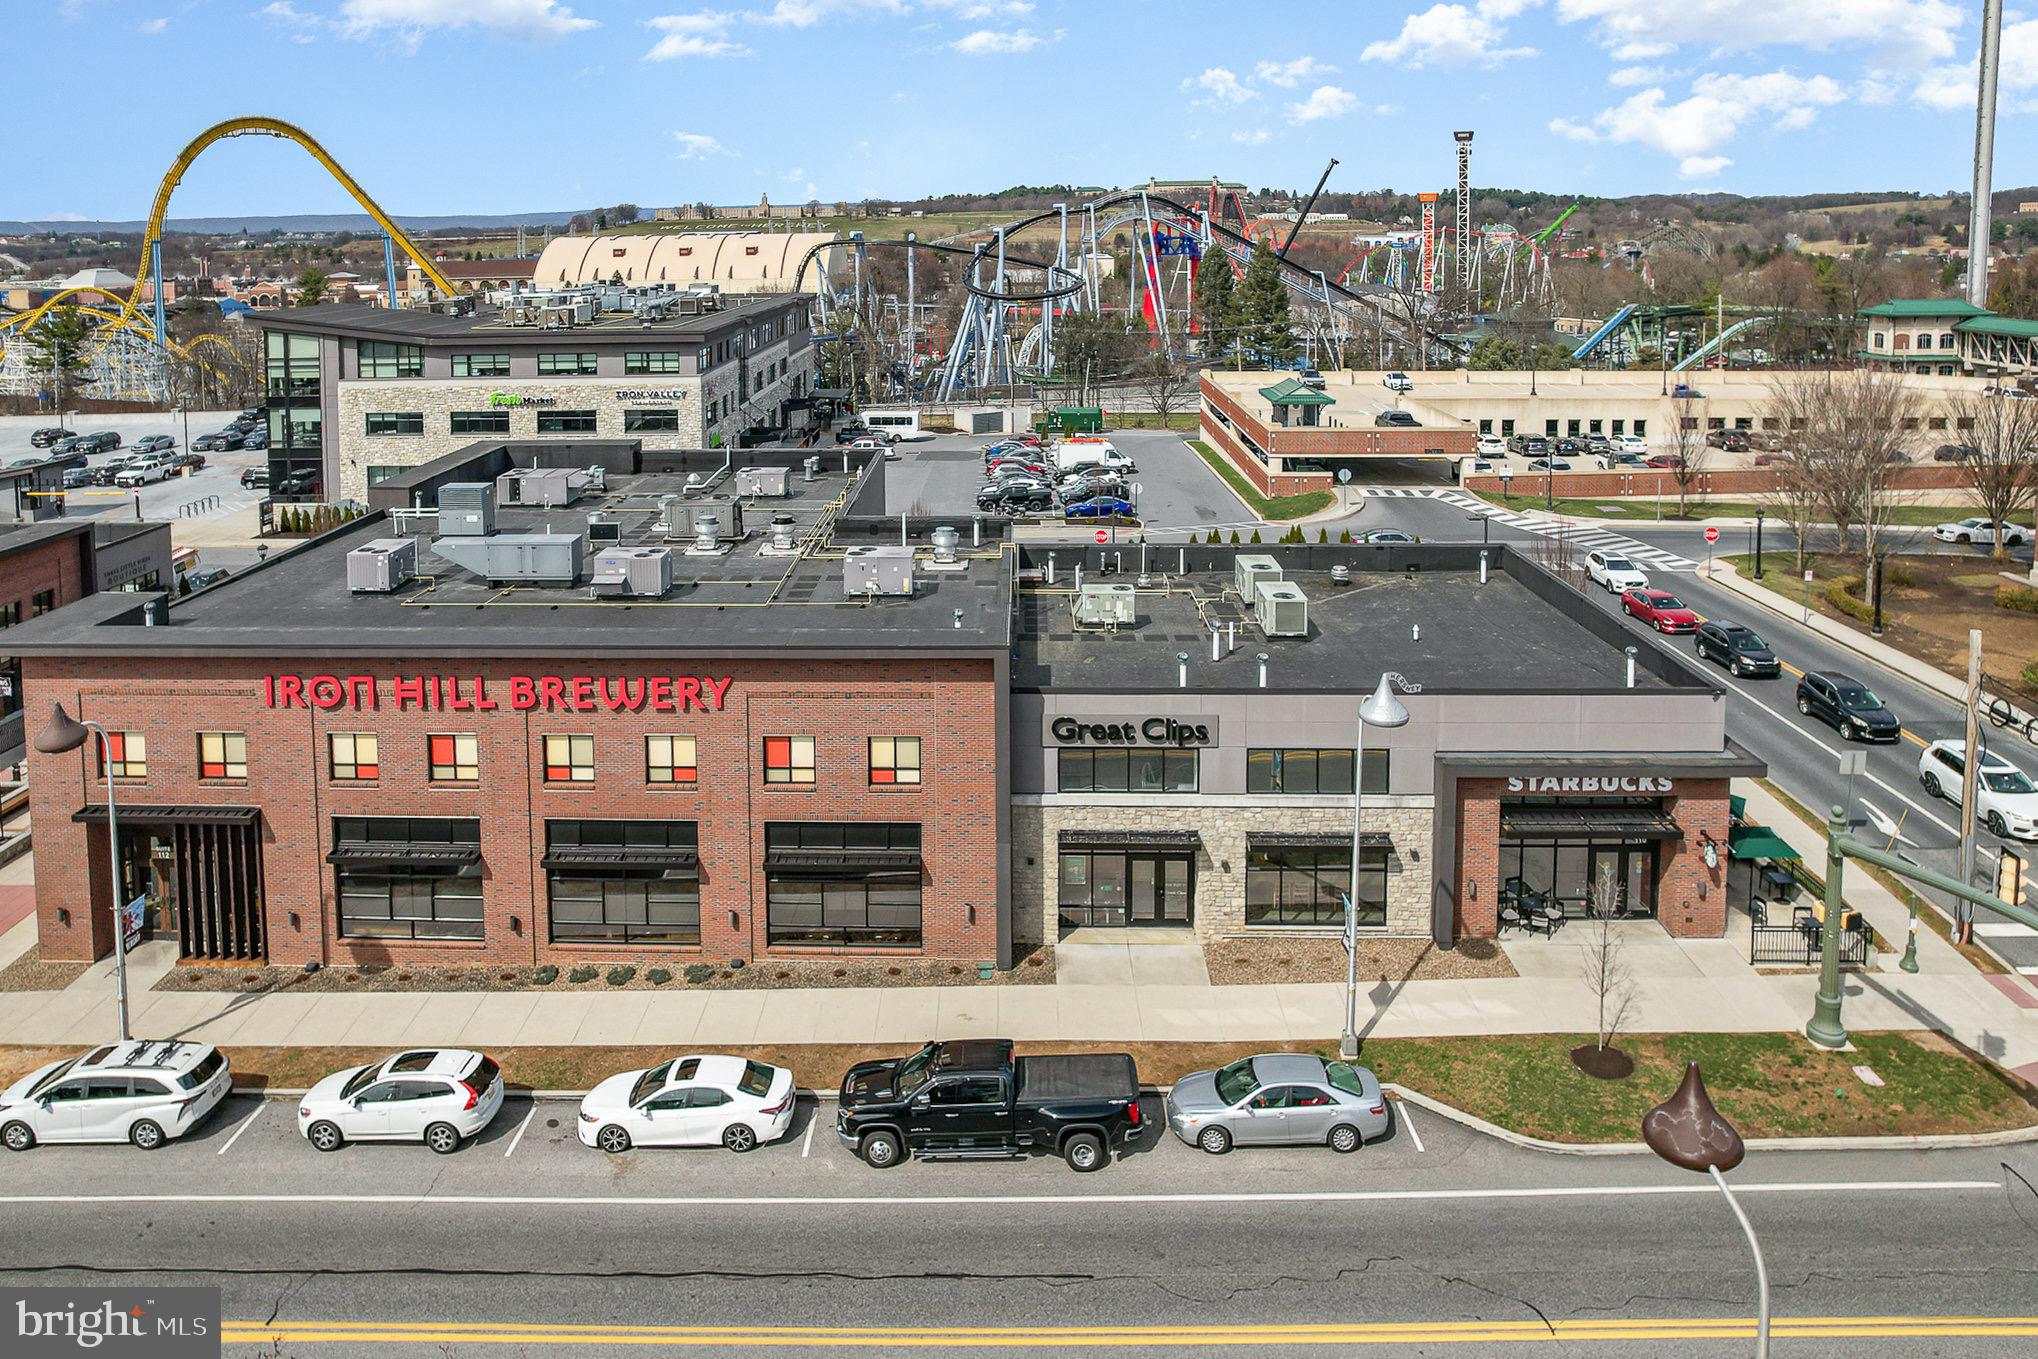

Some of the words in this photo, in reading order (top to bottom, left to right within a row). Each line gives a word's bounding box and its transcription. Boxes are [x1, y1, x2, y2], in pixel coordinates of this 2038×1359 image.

[489, 391, 522, 406] Fresh
[522, 396, 556, 405] Market
[647, 391, 687, 399] VALLEY
[108, 564, 147, 585] BOUTIQUE
[1390, 673, 1421, 692] HERSHEY
[264, 675, 375, 709] IRON
[394, 675, 497, 709] HILL
[510, 675, 733, 710] BREWERY
[1051, 717, 1137, 743] Great
[1141, 717, 1209, 747] Clips
[1508, 776, 1673, 792] STARBUCKS
